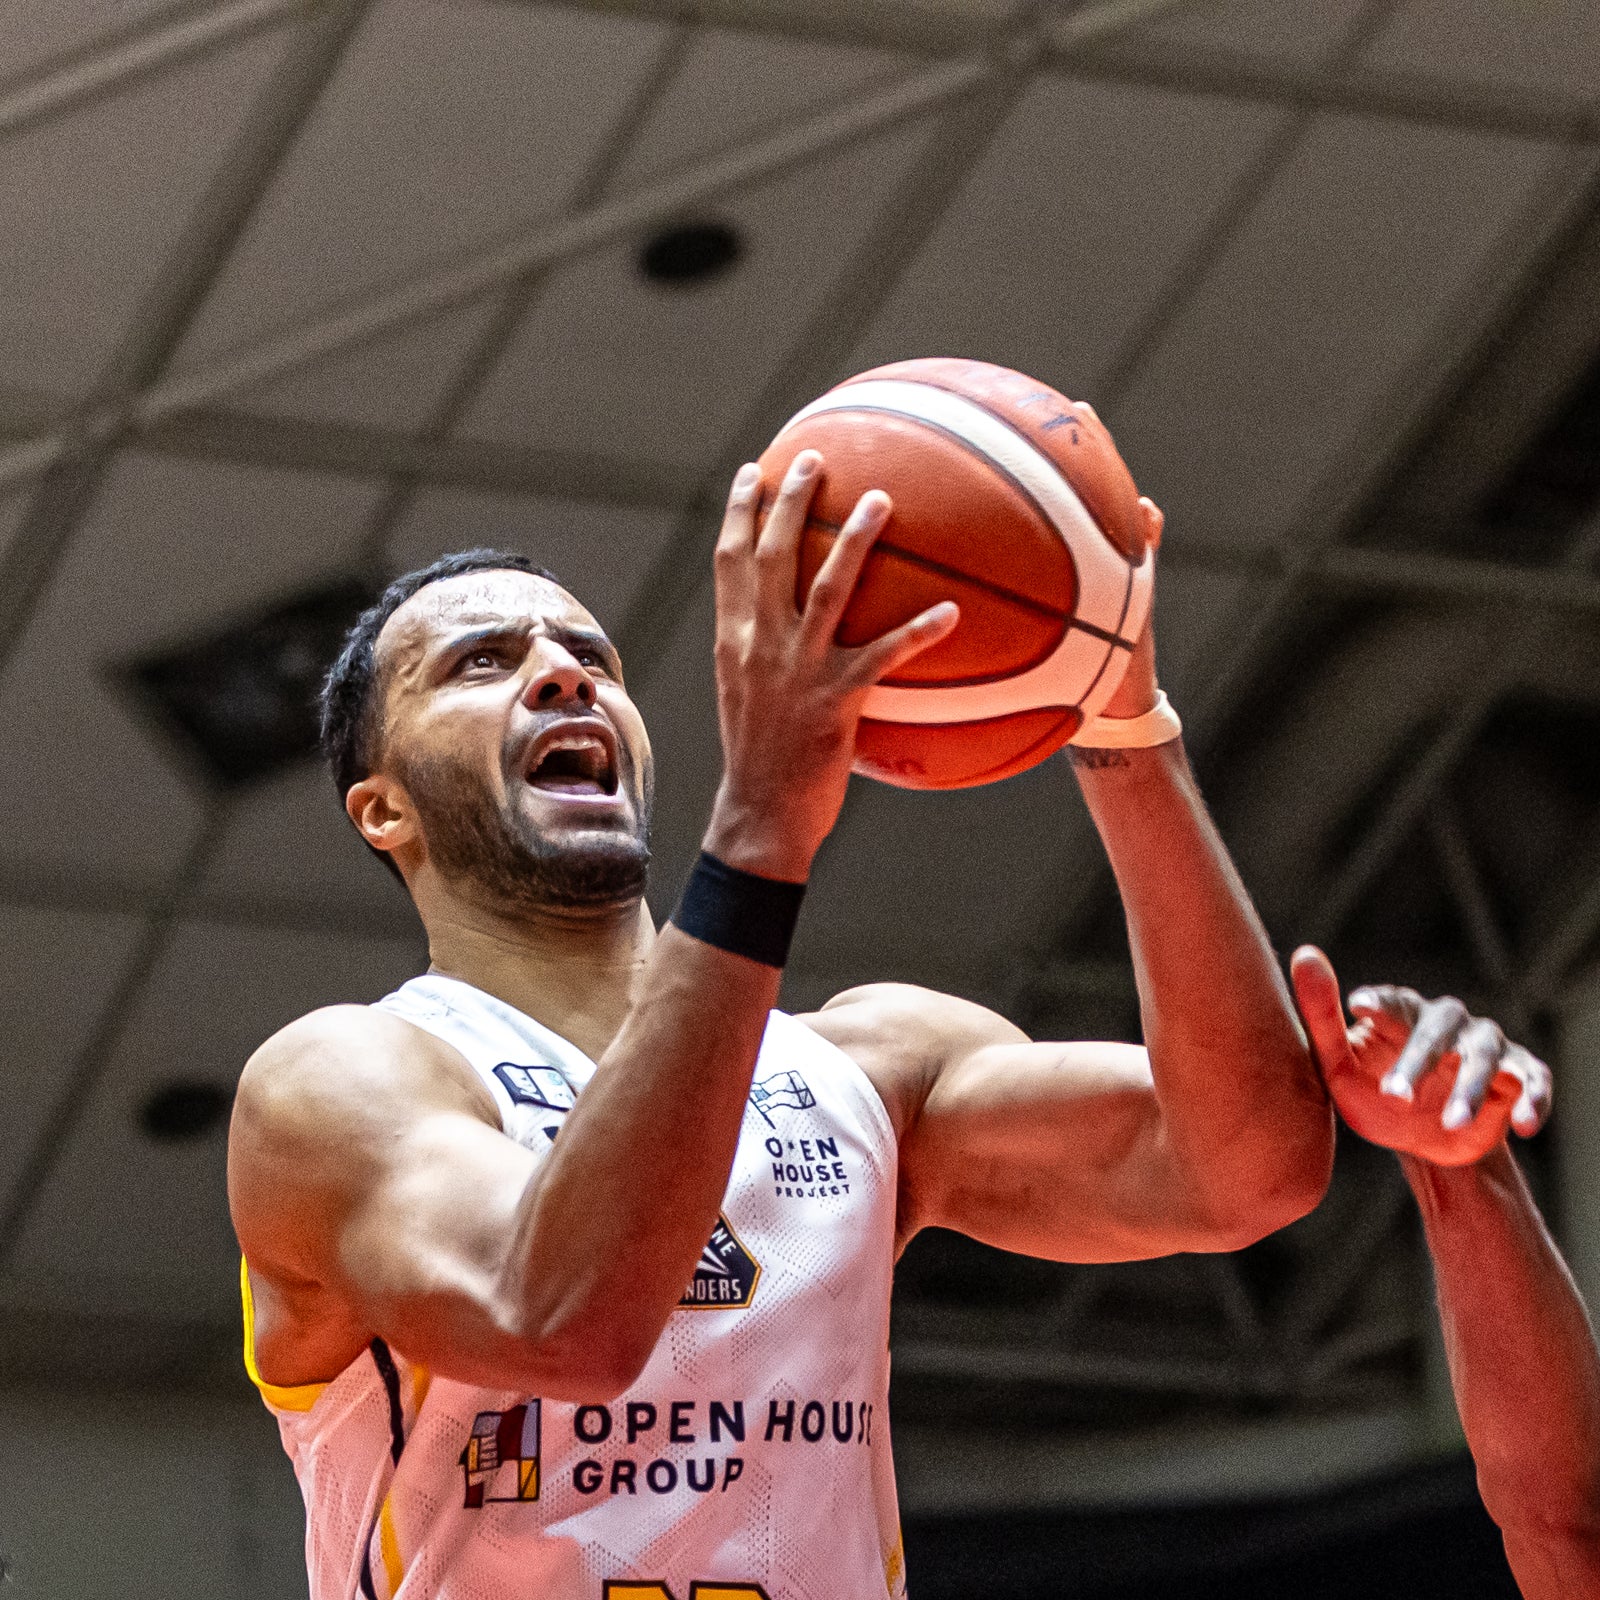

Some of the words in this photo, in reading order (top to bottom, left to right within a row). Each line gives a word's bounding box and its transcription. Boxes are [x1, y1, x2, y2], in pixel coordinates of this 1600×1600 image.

[764, 1136, 840, 1162] OEN
[772, 1161, 848, 1183] HOUSE
[775, 1184, 851, 1198] PROJECT
[683, 1279, 742, 1300] NDERS
[573, 1400, 746, 1445] OPEN
[572, 1457, 745, 1495] GROUP
